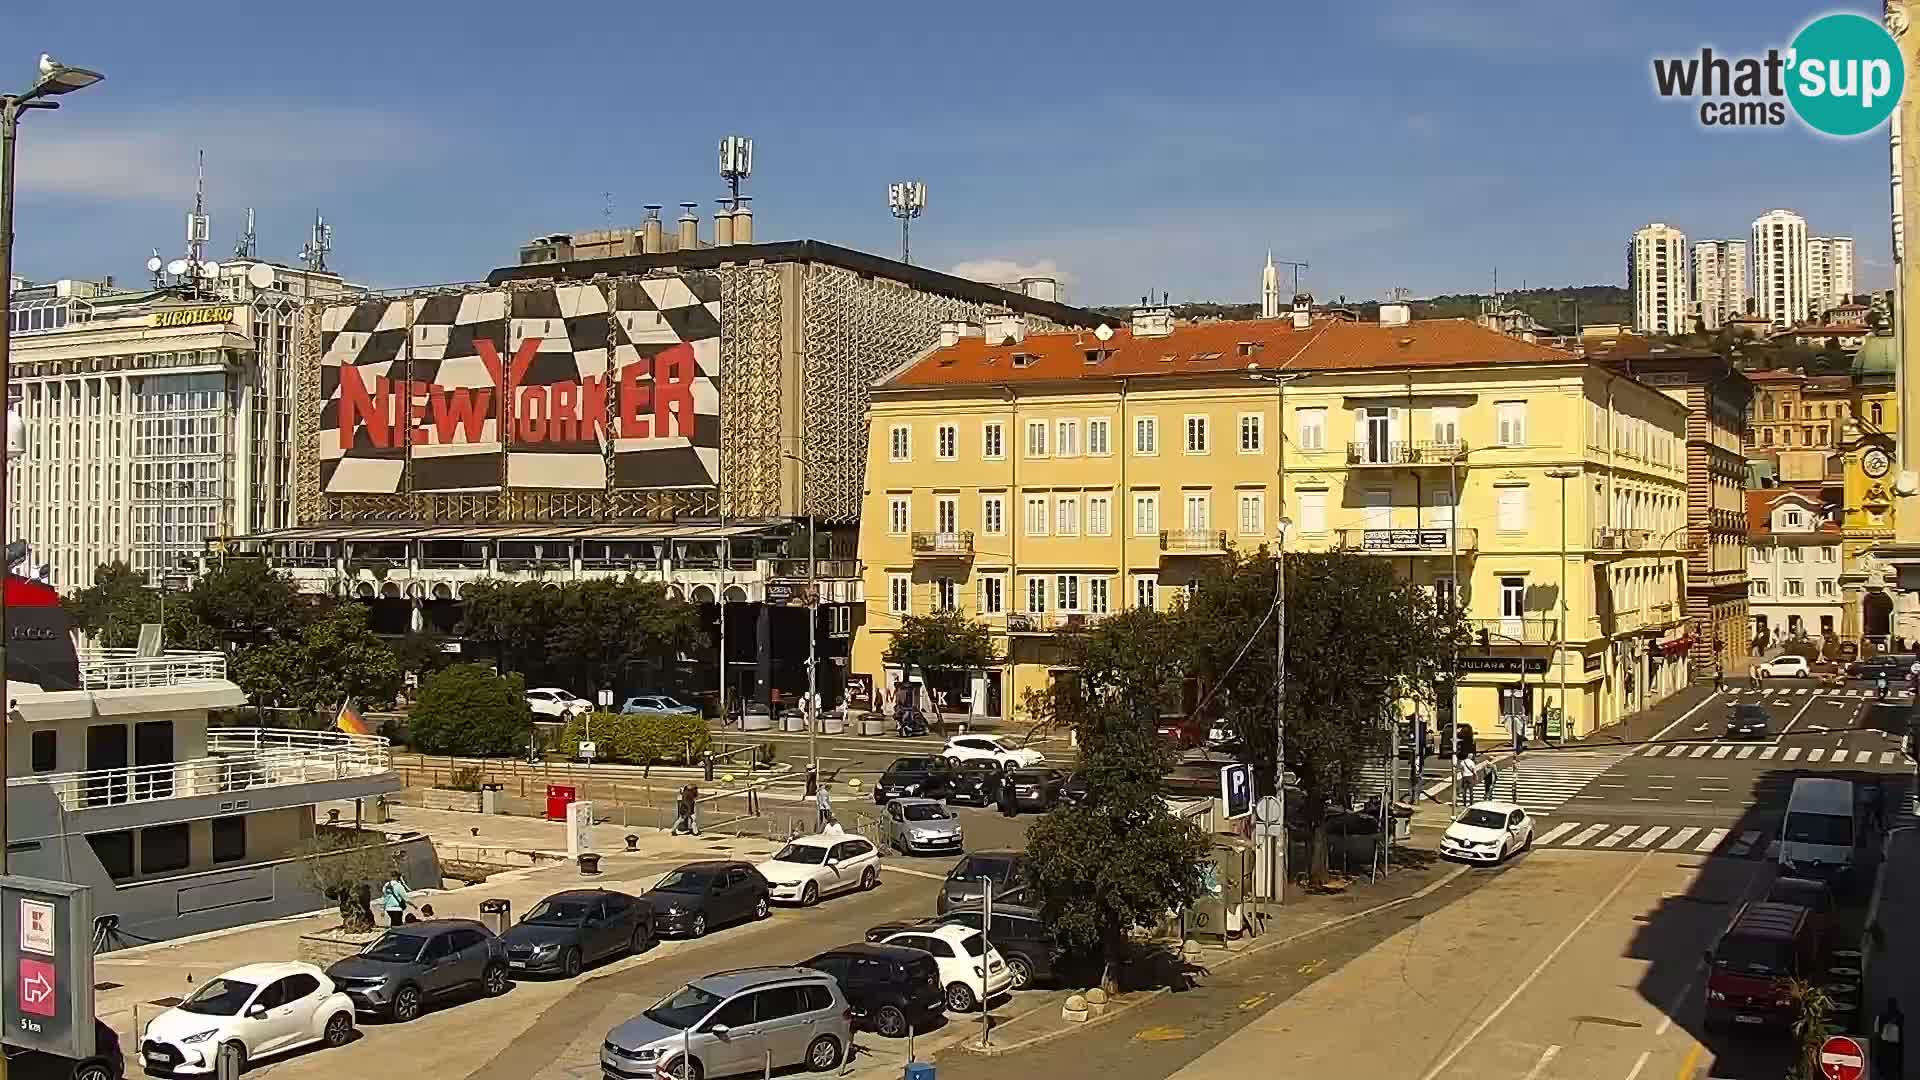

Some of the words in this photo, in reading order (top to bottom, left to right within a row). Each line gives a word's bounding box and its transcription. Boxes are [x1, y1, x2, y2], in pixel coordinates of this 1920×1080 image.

[1232, 770, 1245, 794] P
[20, 1018, 27, 1030] 5
[28, 1018, 42, 1033] km
